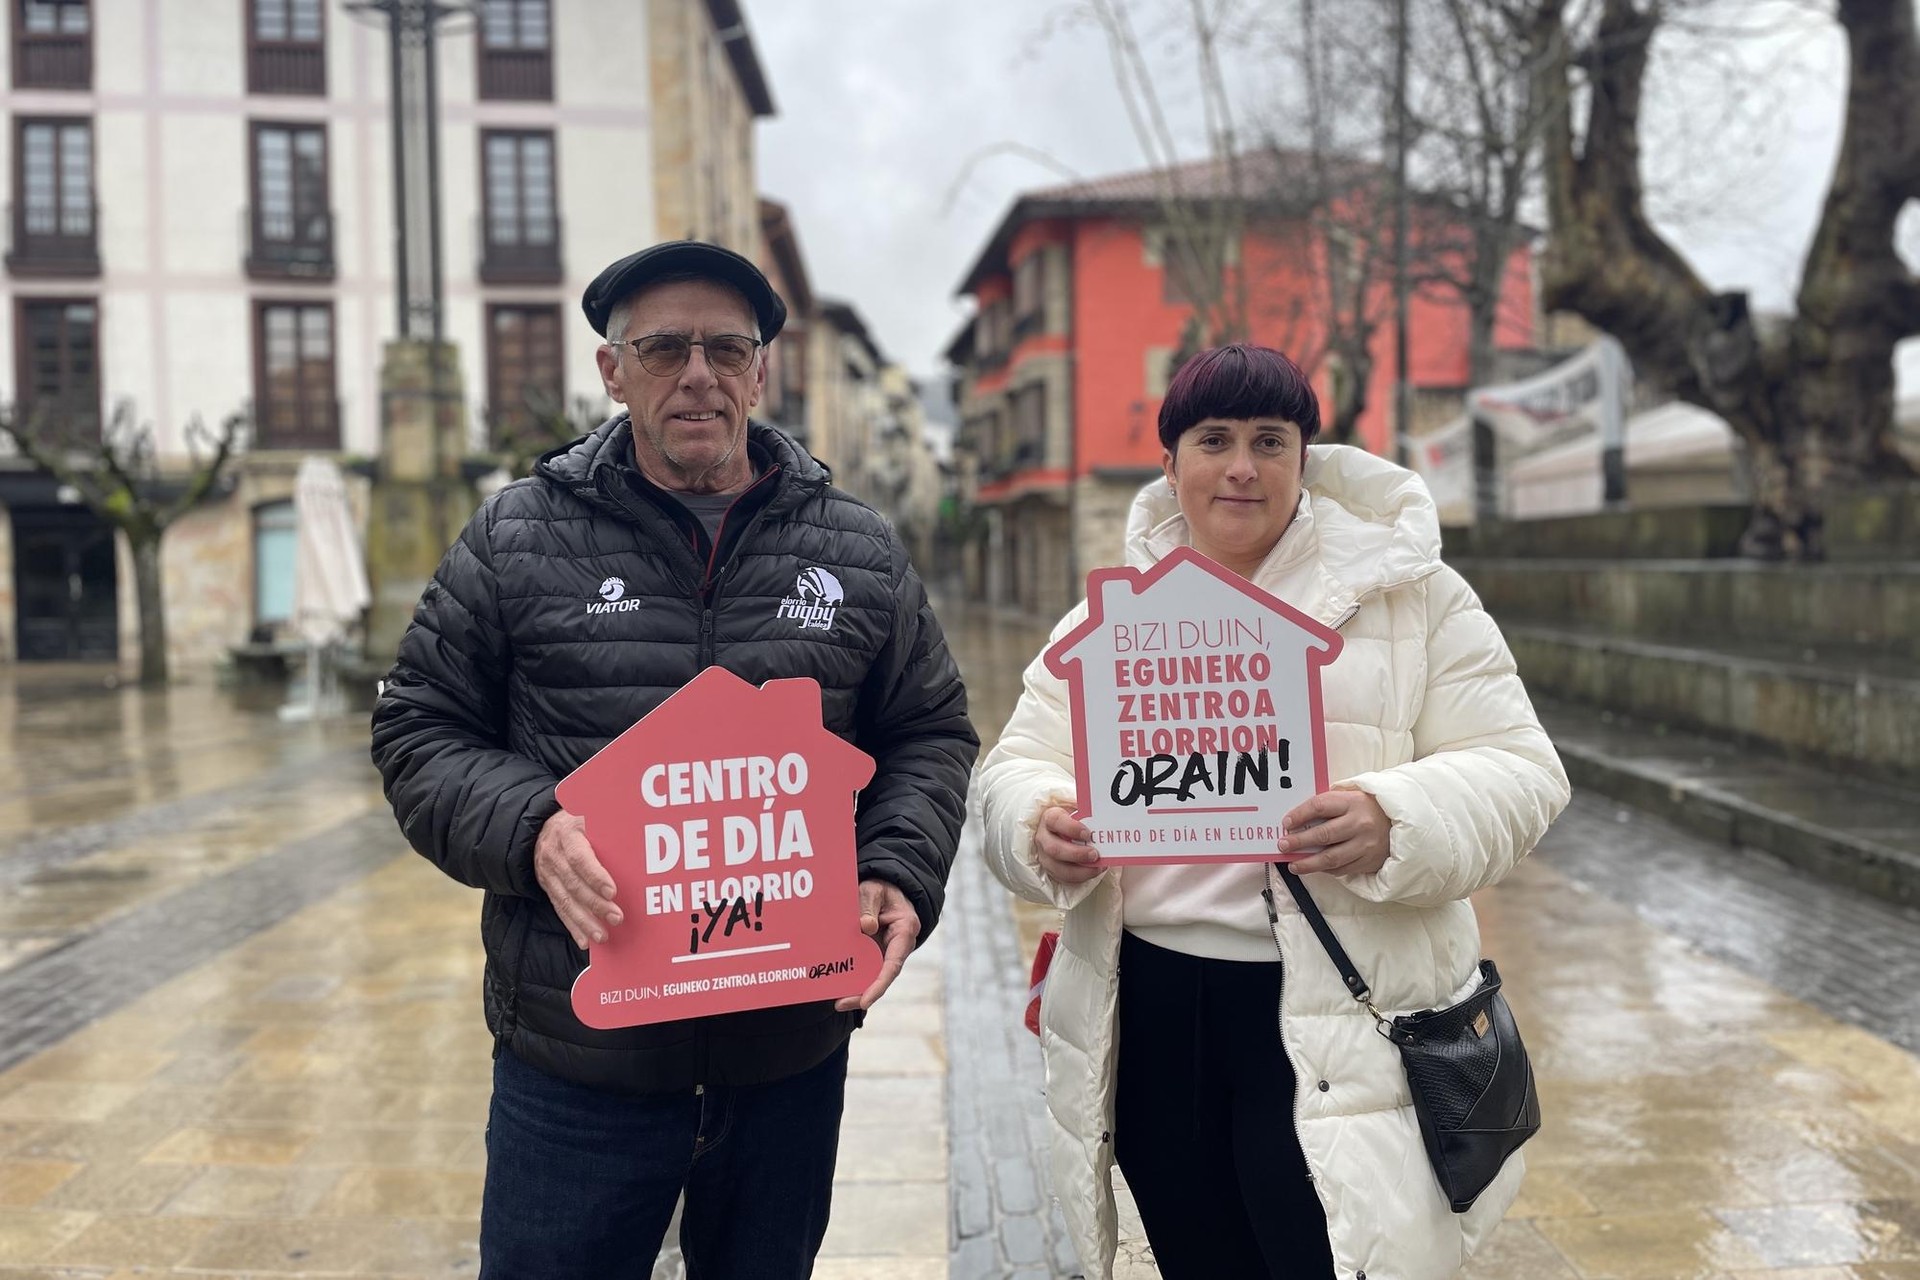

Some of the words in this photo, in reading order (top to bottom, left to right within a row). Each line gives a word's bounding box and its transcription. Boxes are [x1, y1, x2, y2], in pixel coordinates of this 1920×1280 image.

[586, 599, 640, 614] VIATOR
[776, 597, 836, 630] rugby
[781, 595, 807, 605] elorrio
[1113, 621, 1168, 652] BIZI
[1178, 617, 1271, 651] DUIN,
[1114, 652, 1271, 688] EGUNEKO
[1117, 688, 1276, 722] ZENTROA
[1119, 724, 1279, 758] ELORRION
[641, 752, 809, 808] CENTRO
[1110, 738, 1293, 806] ORAIN!
[644, 819, 711, 875] DE
[723, 797, 814, 867] DÍA
[1149, 828, 1166, 842] DE
[1173, 825, 1198, 842] DÍA
[1205, 827, 1222, 841] EN
[646, 883, 684, 916] EN
[691, 869, 814, 911] ELORRIO
[690, 892, 764, 954] ¡YA!
[600, 990, 622, 1005] BIZI
[625, 986, 662, 1002] DUIN,
[663, 979, 710, 997] EGUNEKO
[711, 972, 757, 990] ZENTROA
[758, 966, 807, 984] ELORRION
[808, 957, 854, 979] ORAIN!
